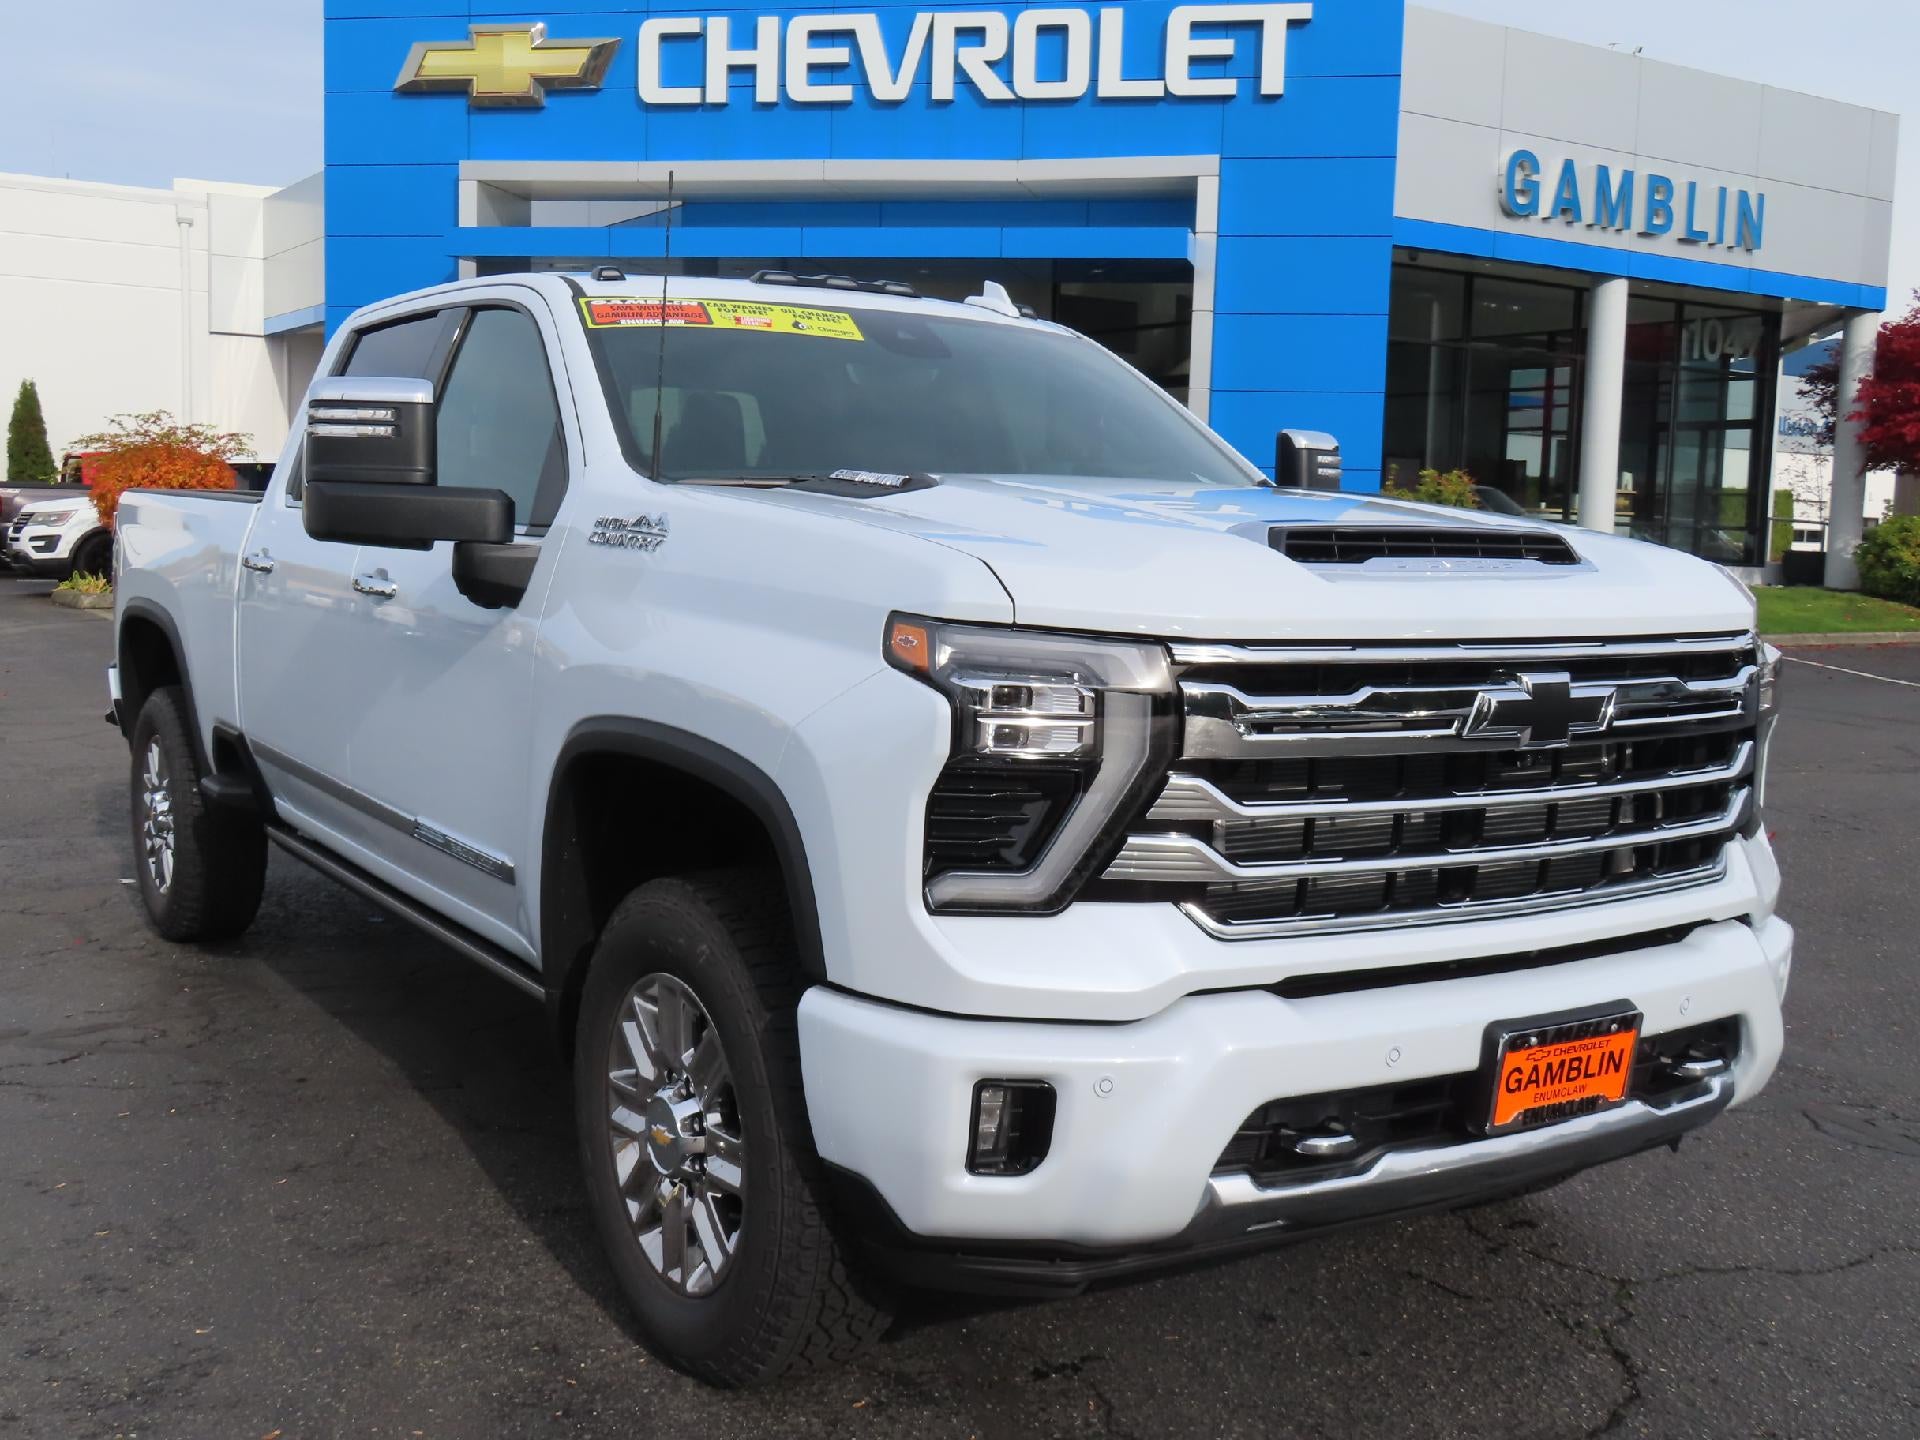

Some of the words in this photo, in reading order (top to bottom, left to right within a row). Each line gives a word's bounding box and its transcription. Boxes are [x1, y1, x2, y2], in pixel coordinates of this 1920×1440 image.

[637, 3, 1312, 105] CHEVROLET
[1501, 149, 1764, 250] GAMBLIN
[1505, 1048, 1624, 1094] GAMBLIN
[1553, 1039, 1611, 1057] CHEVROLET
[1533, 1083, 1588, 1103] ENUMCLAW
